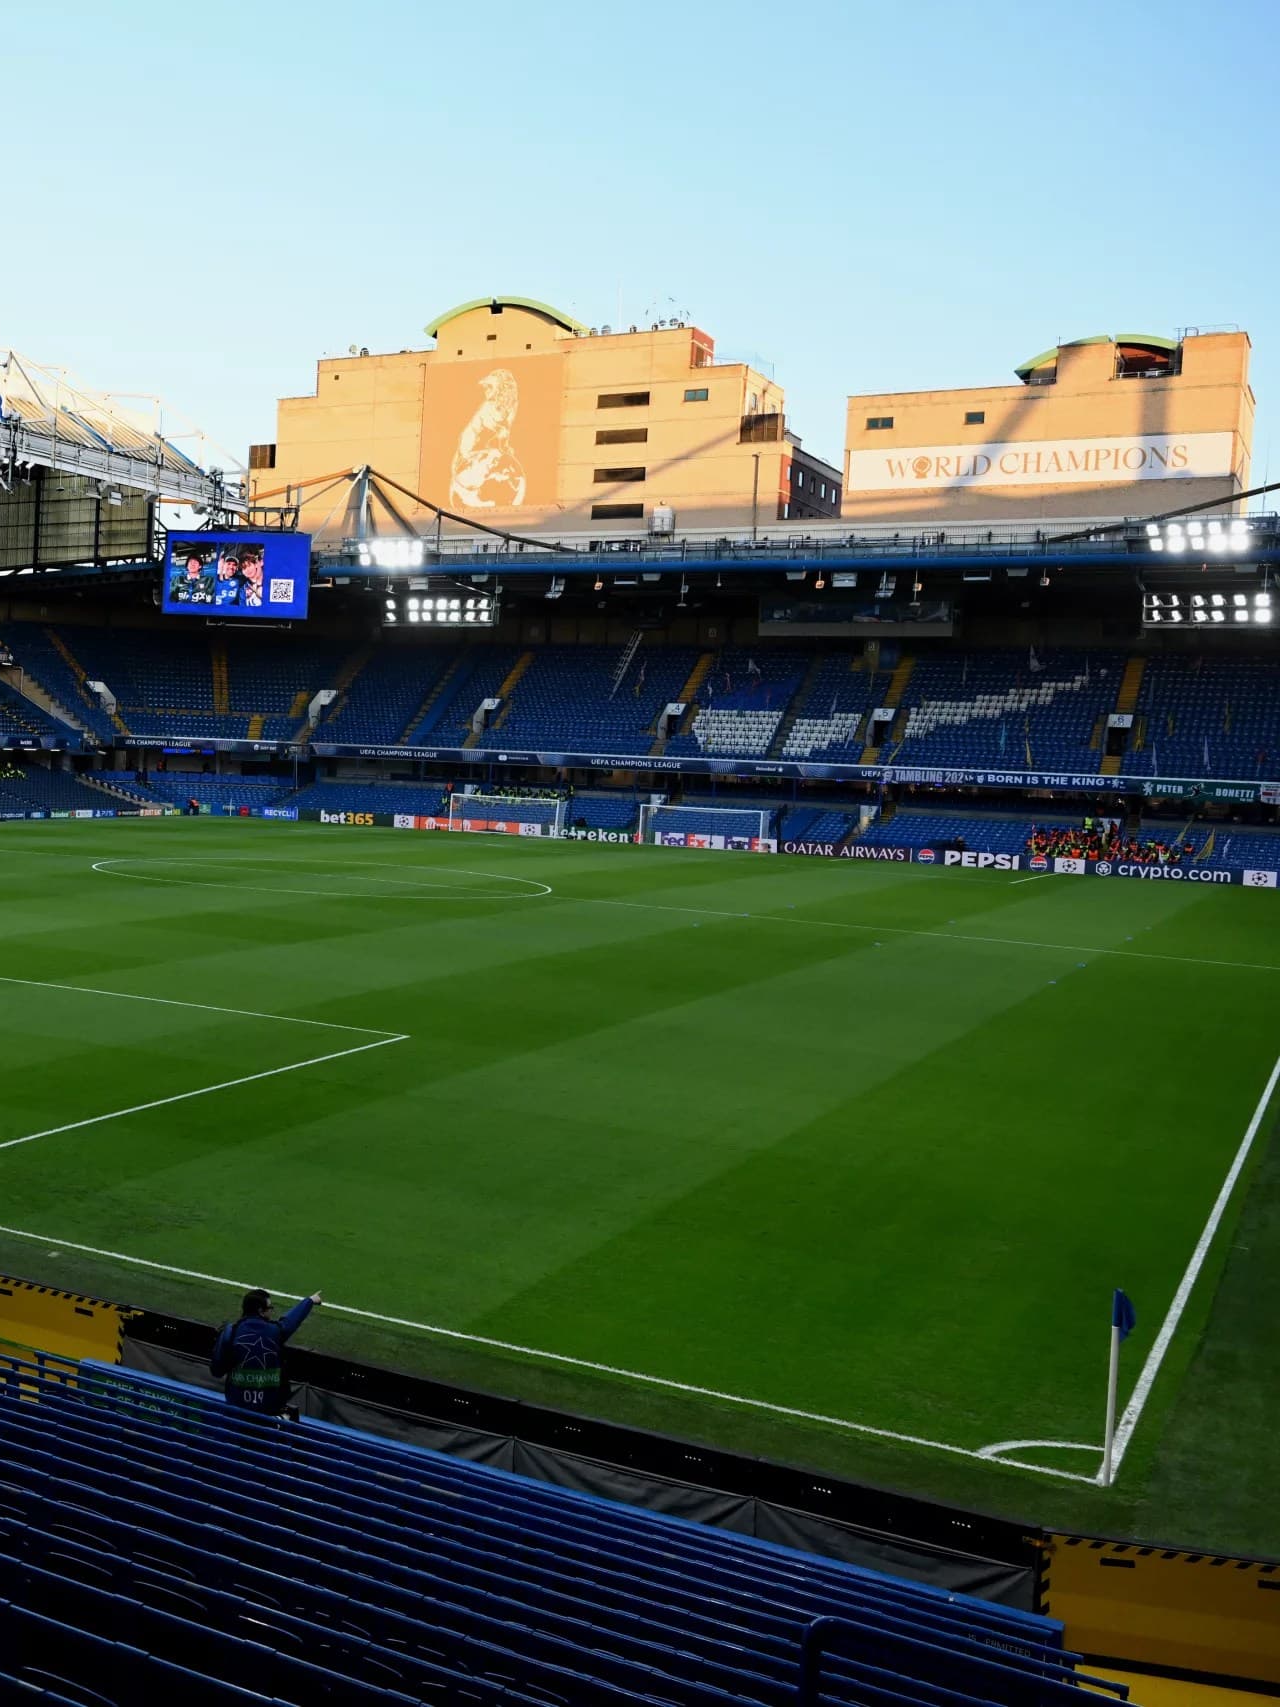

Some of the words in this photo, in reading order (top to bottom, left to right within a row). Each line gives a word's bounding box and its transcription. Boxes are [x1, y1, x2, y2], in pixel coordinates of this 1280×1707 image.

[886, 454, 991, 481] WORLD
[1000, 445, 1188, 476] CHAMPIONS
[376, 750, 413, 758] CHAMPIONS
[414, 751, 437, 759] LEAGUE
[591, 758, 609, 766] UEFA
[610, 759, 651, 768] CHAMPIONS
[653, 761, 681, 769] LEAGUE
[895, 770, 943, 783] TAMBLING
[987, 774, 1023, 784] BORN
[1027, 776, 1039, 785] IS
[1042, 776, 1068, 785] THE
[1072, 777, 1104, 786] KING
[1156, 784, 1183, 794] PETER
[1215, 788, 1255, 798] BONETTI
[320, 810, 374, 826] bet365
[784, 842, 833, 857] QATAR
[840, 845, 904, 862] AIRWAYS
[944, 850, 1019, 871] PEPSI
[1118, 864, 1231, 883] crypto.com
